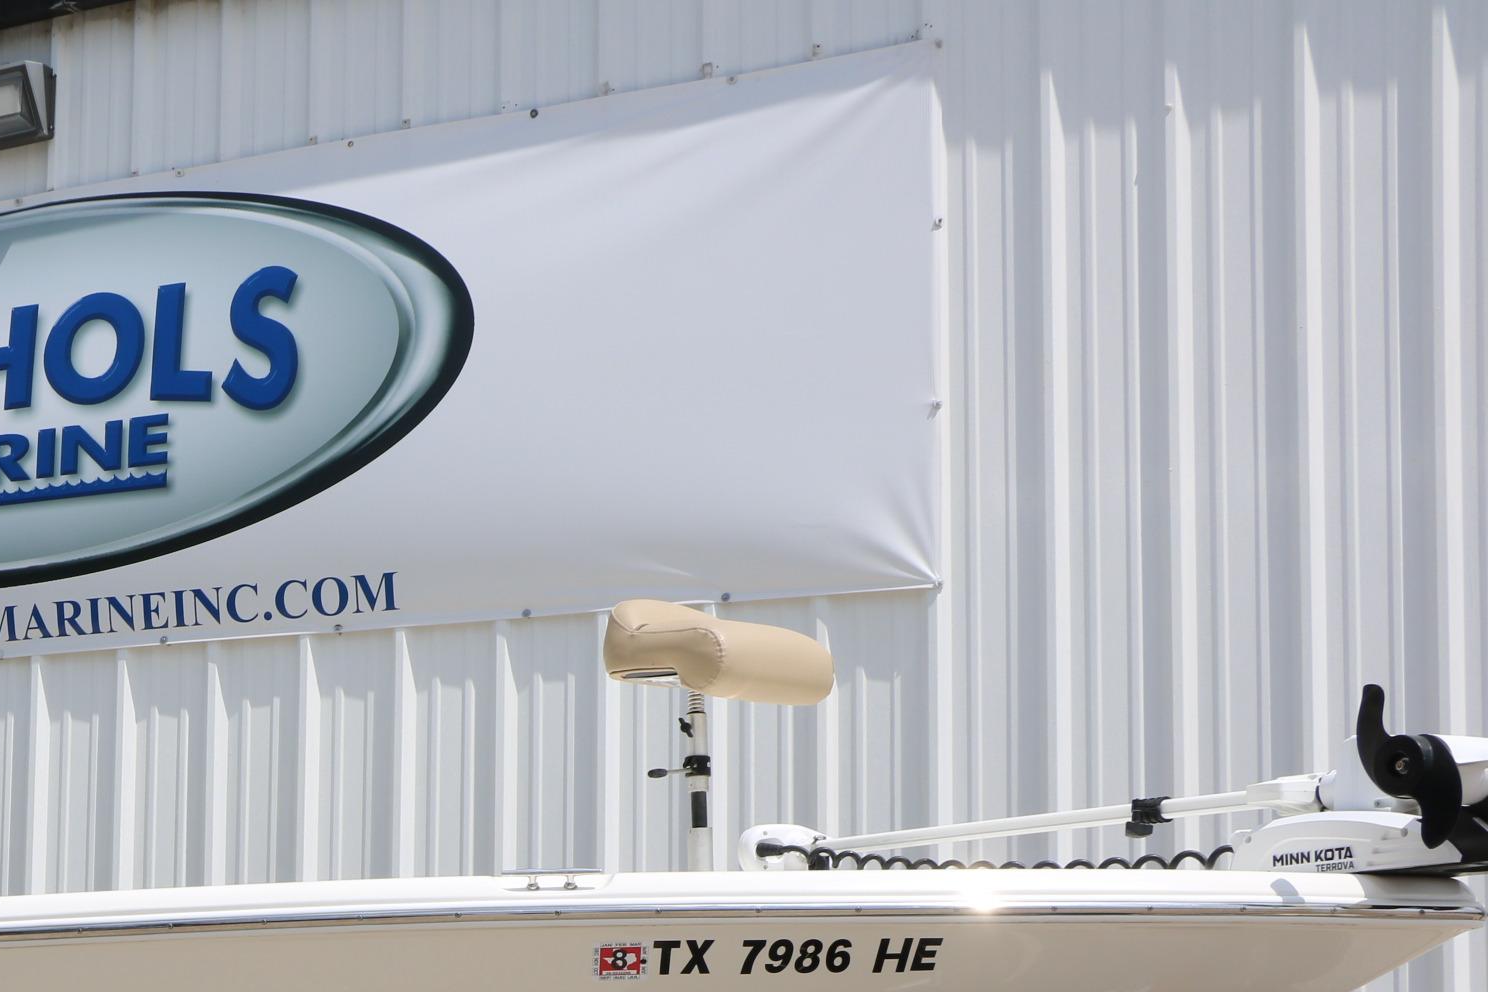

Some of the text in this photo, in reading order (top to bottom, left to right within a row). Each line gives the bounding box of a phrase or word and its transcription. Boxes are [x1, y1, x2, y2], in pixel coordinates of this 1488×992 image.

[1272, 846, 1354, 867] MINN KOTA
[1315, 861, 1354, 872] TERROVA
[653, 939, 715, 975] TX
[739, 938, 853, 975] 7986
[871, 937, 944, 973] HE
